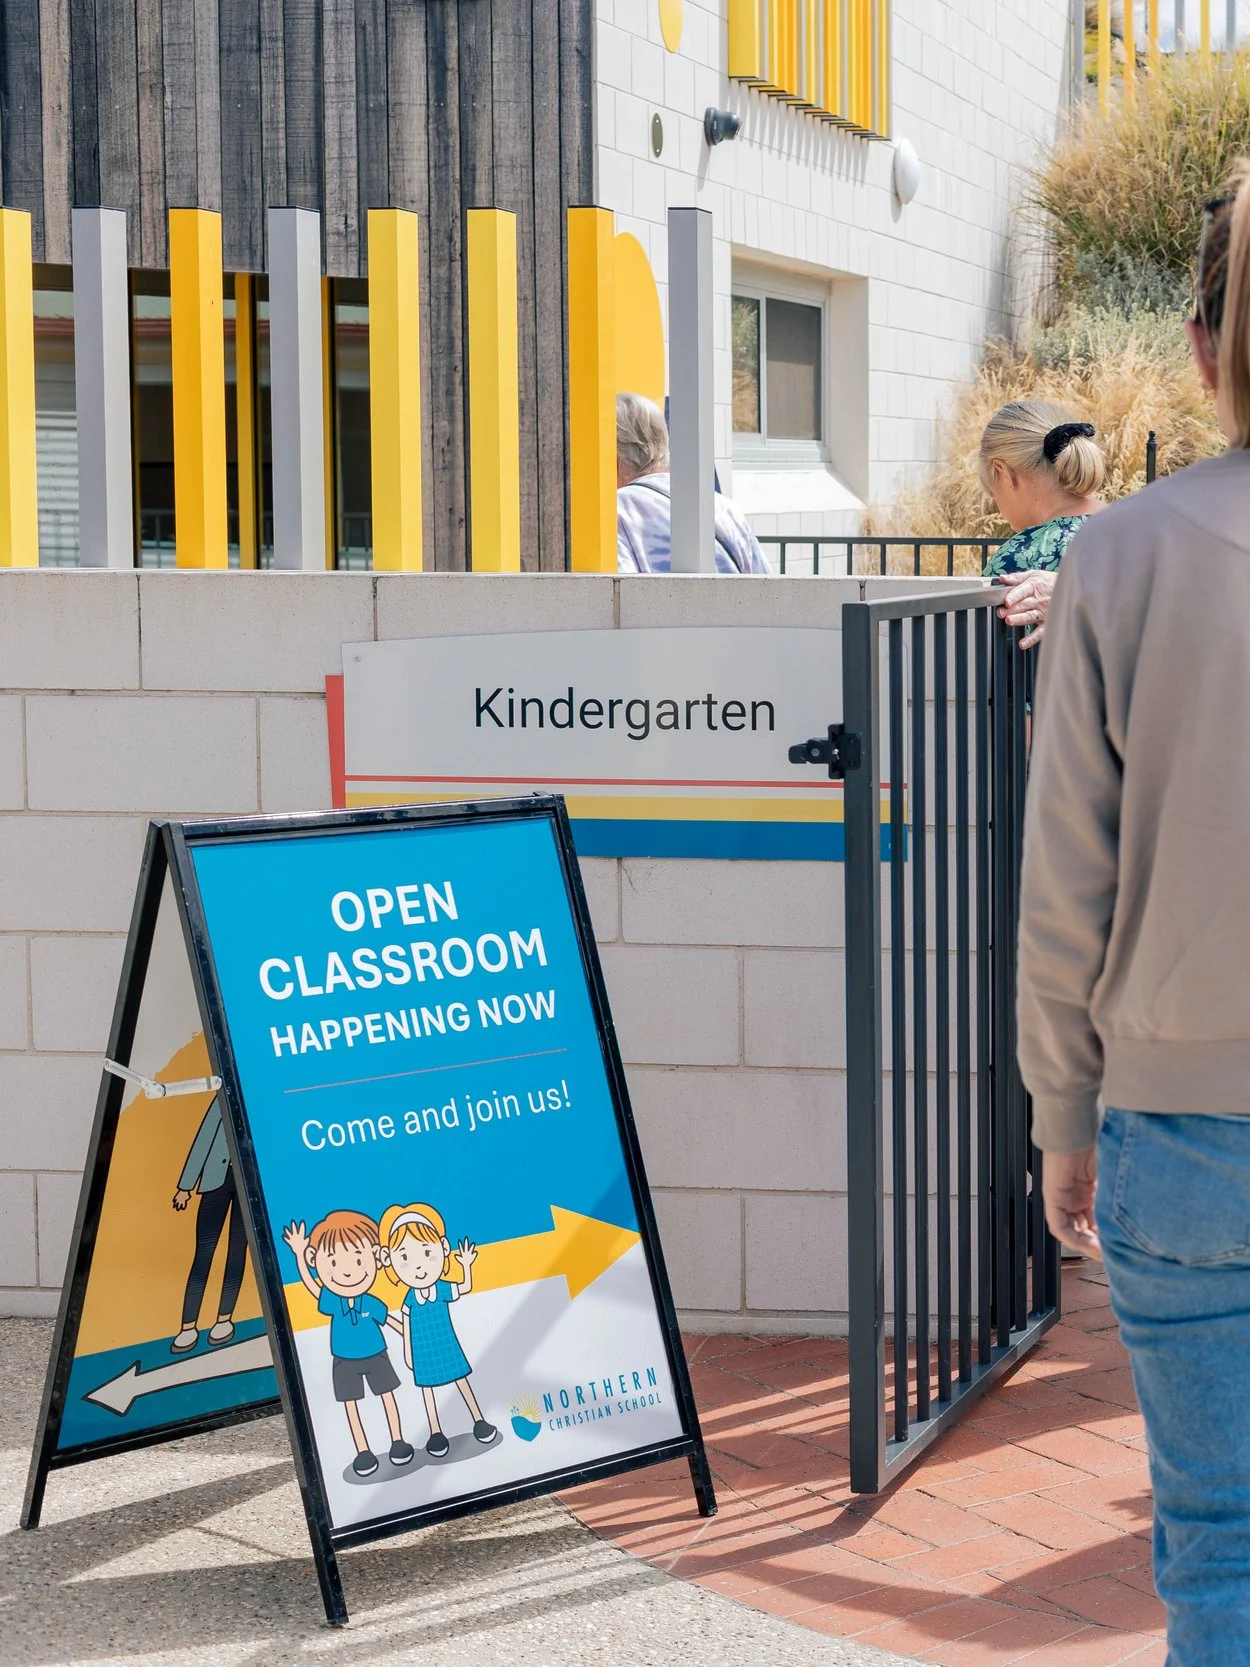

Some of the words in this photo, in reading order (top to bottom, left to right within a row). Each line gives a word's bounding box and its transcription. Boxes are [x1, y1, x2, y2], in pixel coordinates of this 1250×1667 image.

[474, 686, 776, 741] Kindergarten
[331, 880, 459, 932] OPEN
[258, 927, 548, 1000] CLASSROOM
[270, 1002, 471, 1057] HAPPENING
[477, 989, 556, 1028] NOW
[301, 1114, 396, 1151] Come
[404, 1097, 460, 1135] and
[465, 1090, 521, 1132] join
[528, 1079, 572, 1113] us!
[542, 1367, 658, 1413] NORTHERN
[549, 1405, 612, 1431] CHRISTIAN
[617, 1391, 662, 1414] SCHOOL
